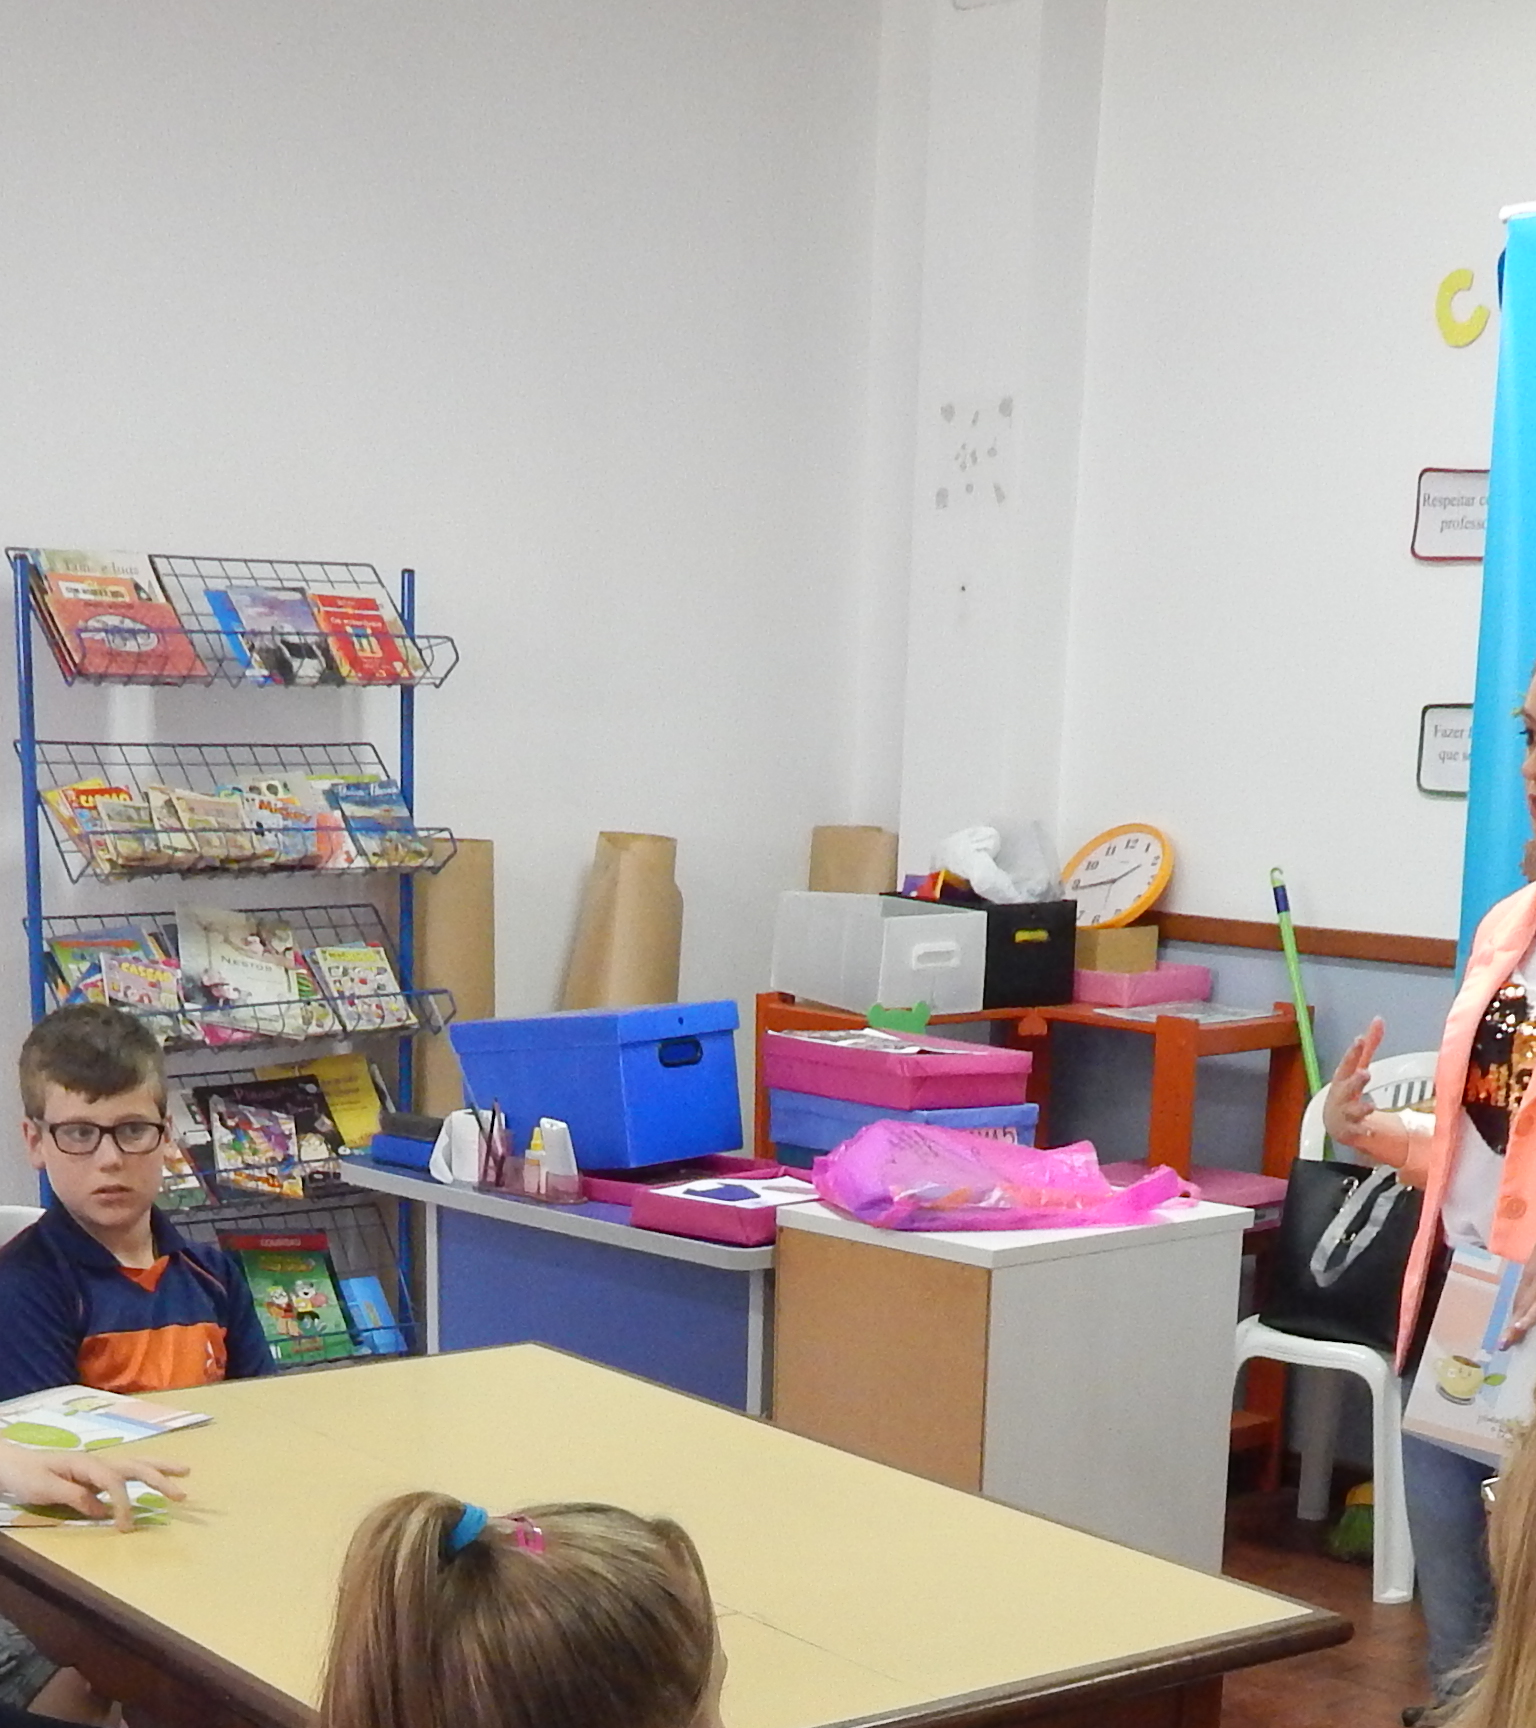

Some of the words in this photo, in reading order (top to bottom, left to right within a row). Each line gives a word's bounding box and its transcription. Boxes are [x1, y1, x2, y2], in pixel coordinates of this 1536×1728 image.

[1125, 839, 1139, 850] 12
[1105, 845, 1116, 857] 11
[1085, 861, 1099, 871] 10
